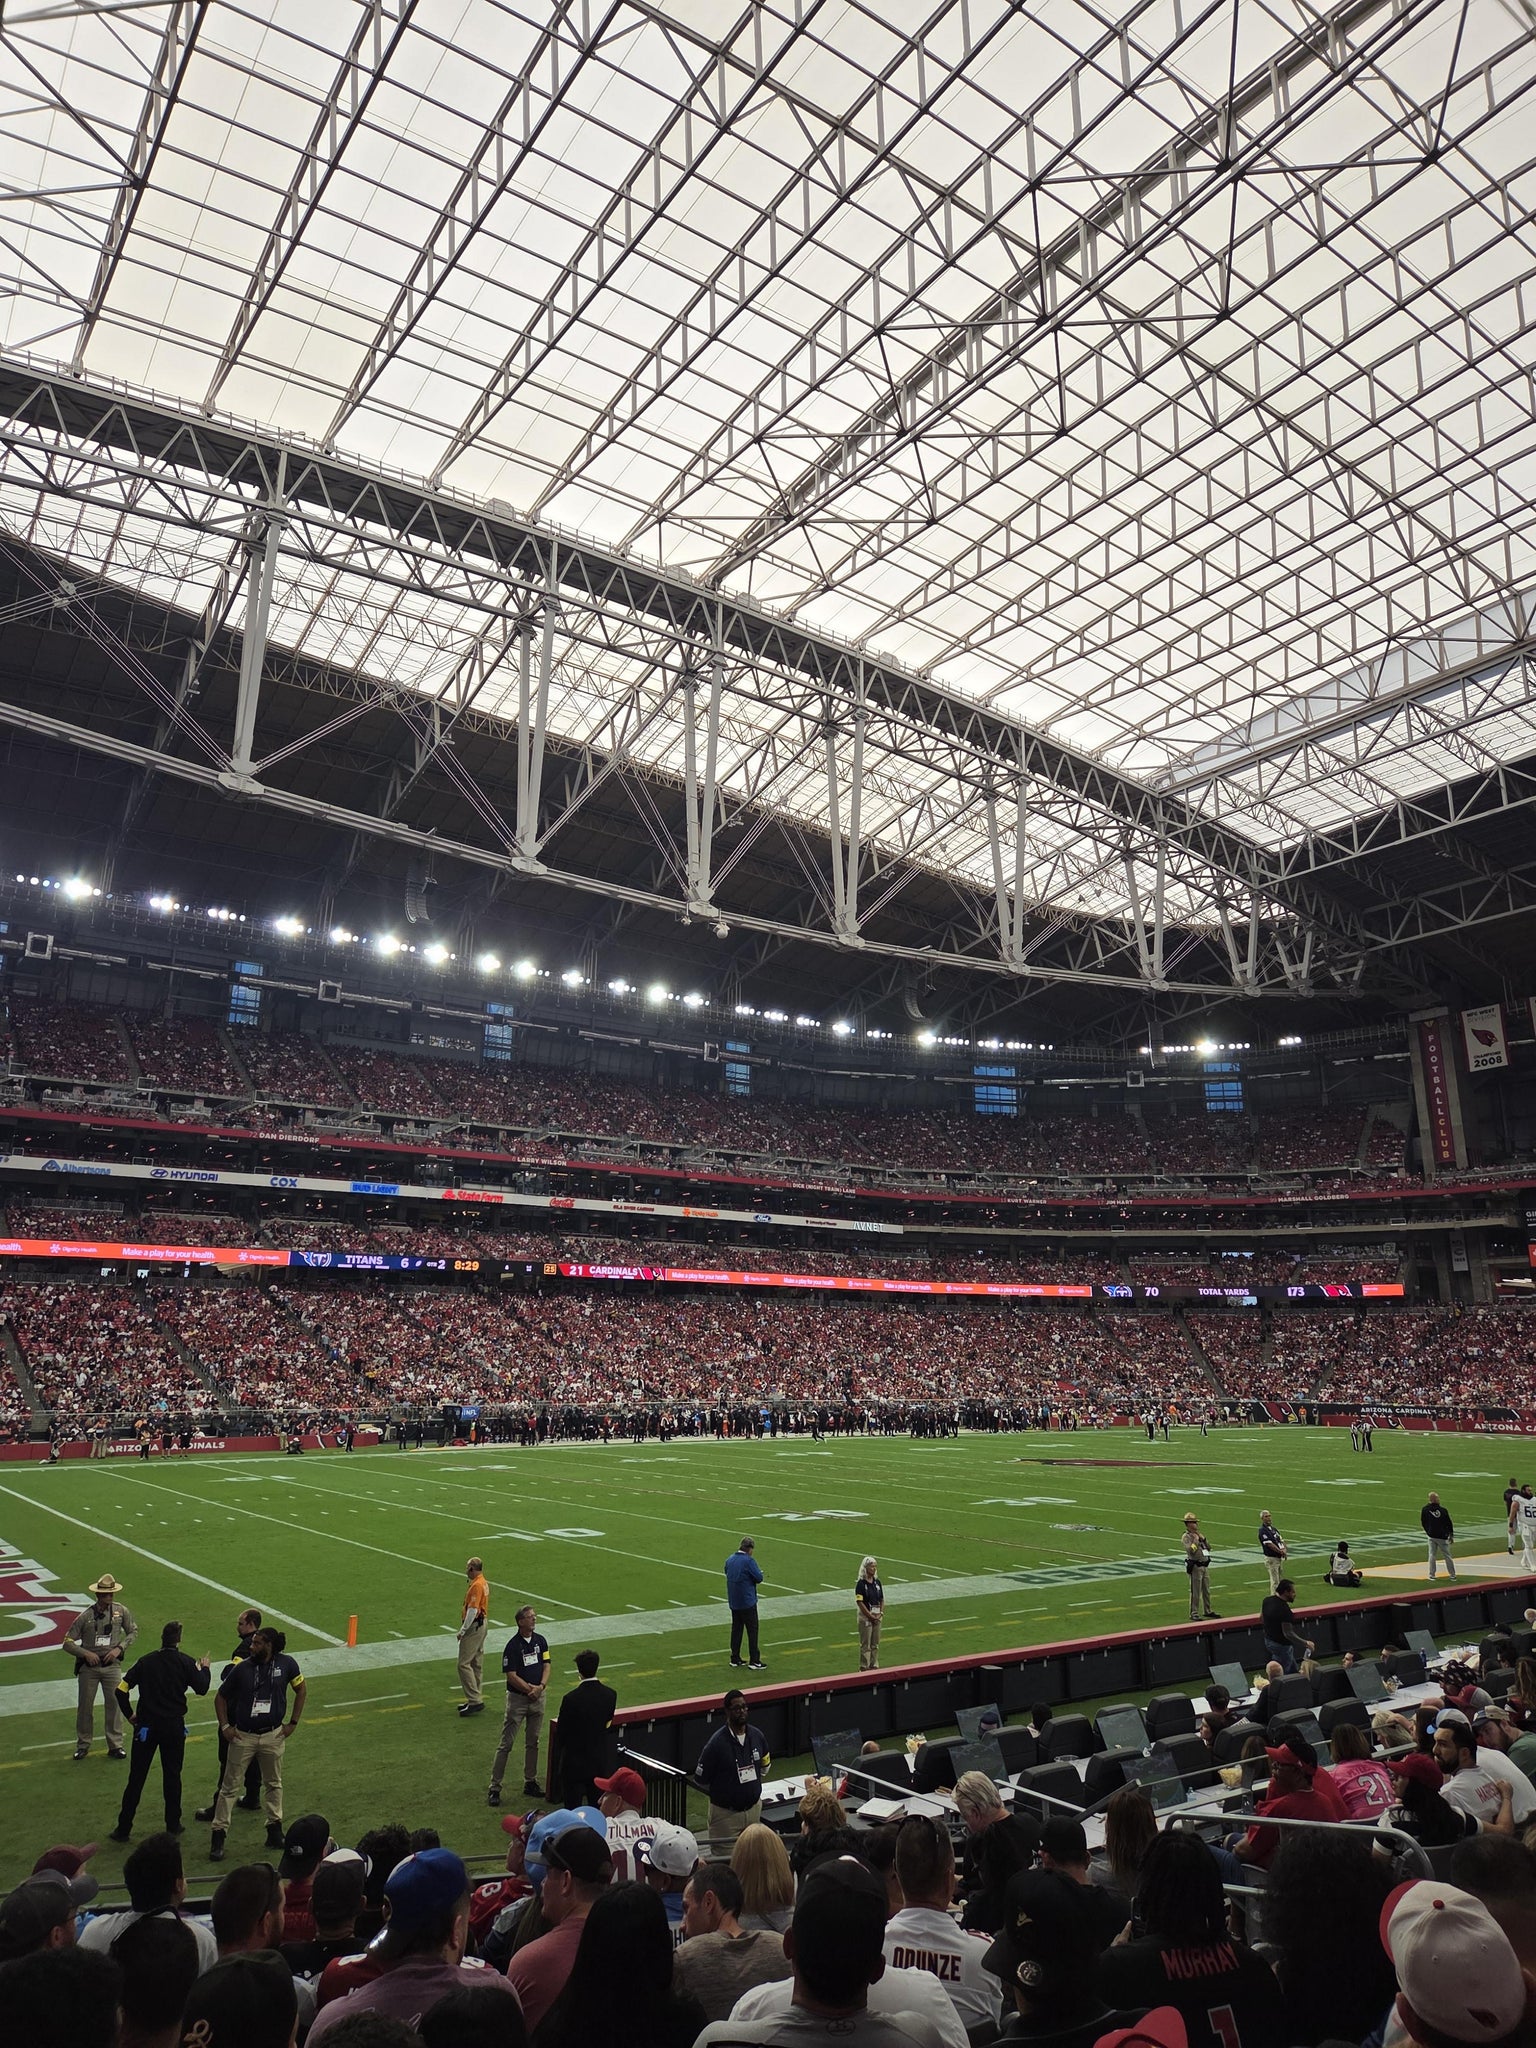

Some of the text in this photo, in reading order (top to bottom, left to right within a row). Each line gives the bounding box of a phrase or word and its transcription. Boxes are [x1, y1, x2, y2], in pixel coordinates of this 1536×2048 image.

[1473, 1055, 1503, 1068] 2008
[1427, 1034, 1444, 1116] FOOTBALL
[259, 1132, 277, 1140] DAN
[278, 1133, 320, 1144] DIERDORF
[1438, 1118, 1450, 1159] CLUB
[517, 1156, 539, 1164] LARRY
[539, 1158, 567, 1166] WILSON
[61, 1163, 112, 1176] Albertsons
[170, 1170, 219, 1182] HYUNDAI
[270, 1177, 298, 1188] COX
[352, 1184, 399, 1194] BUD LIGHT
[458, 1190, 504, 1202] State Farm
[1314, 1193, 1350, 1201] GOLDBERG
[757, 1214, 770, 1222] Ford
[853, 1221, 884, 1232] AVNET
[62, 1246, 80, 1254] Dignity
[122, 1247, 143, 1256] Make
[149, 1249, 164, 1259] play
[165, 1250, 175, 1258] for
[192, 1250, 216, 1259] health.
[345, 1254, 384, 1265] TITANS
[400, 1258, 410, 1269] 6
[438, 1259, 446, 1270] 2
[453, 1260, 480, 1272] 8:29
[544, 1265, 556, 1274] 25
[569, 1265, 638, 1276] 21 CARDINALS
[1145, 1287, 1159, 1297] 70
[1198, 1288, 1250, 1296] TOTAL YARDS
[1287, 1287, 1306, 1297] 173
[108, 1443, 159, 1453] ARIZOA
[760, 1509, 871, 1522] 20
[496, 1527, 605, 1542] 10
[1356, 1772, 1393, 1807] 21
[607, 1823, 655, 1840] TILLMAN
[892, 1945, 962, 1982] ODUNZE
[1160, 1941, 1240, 1981] MURRAY
[1207, 2003, 1242, 2048] 1
